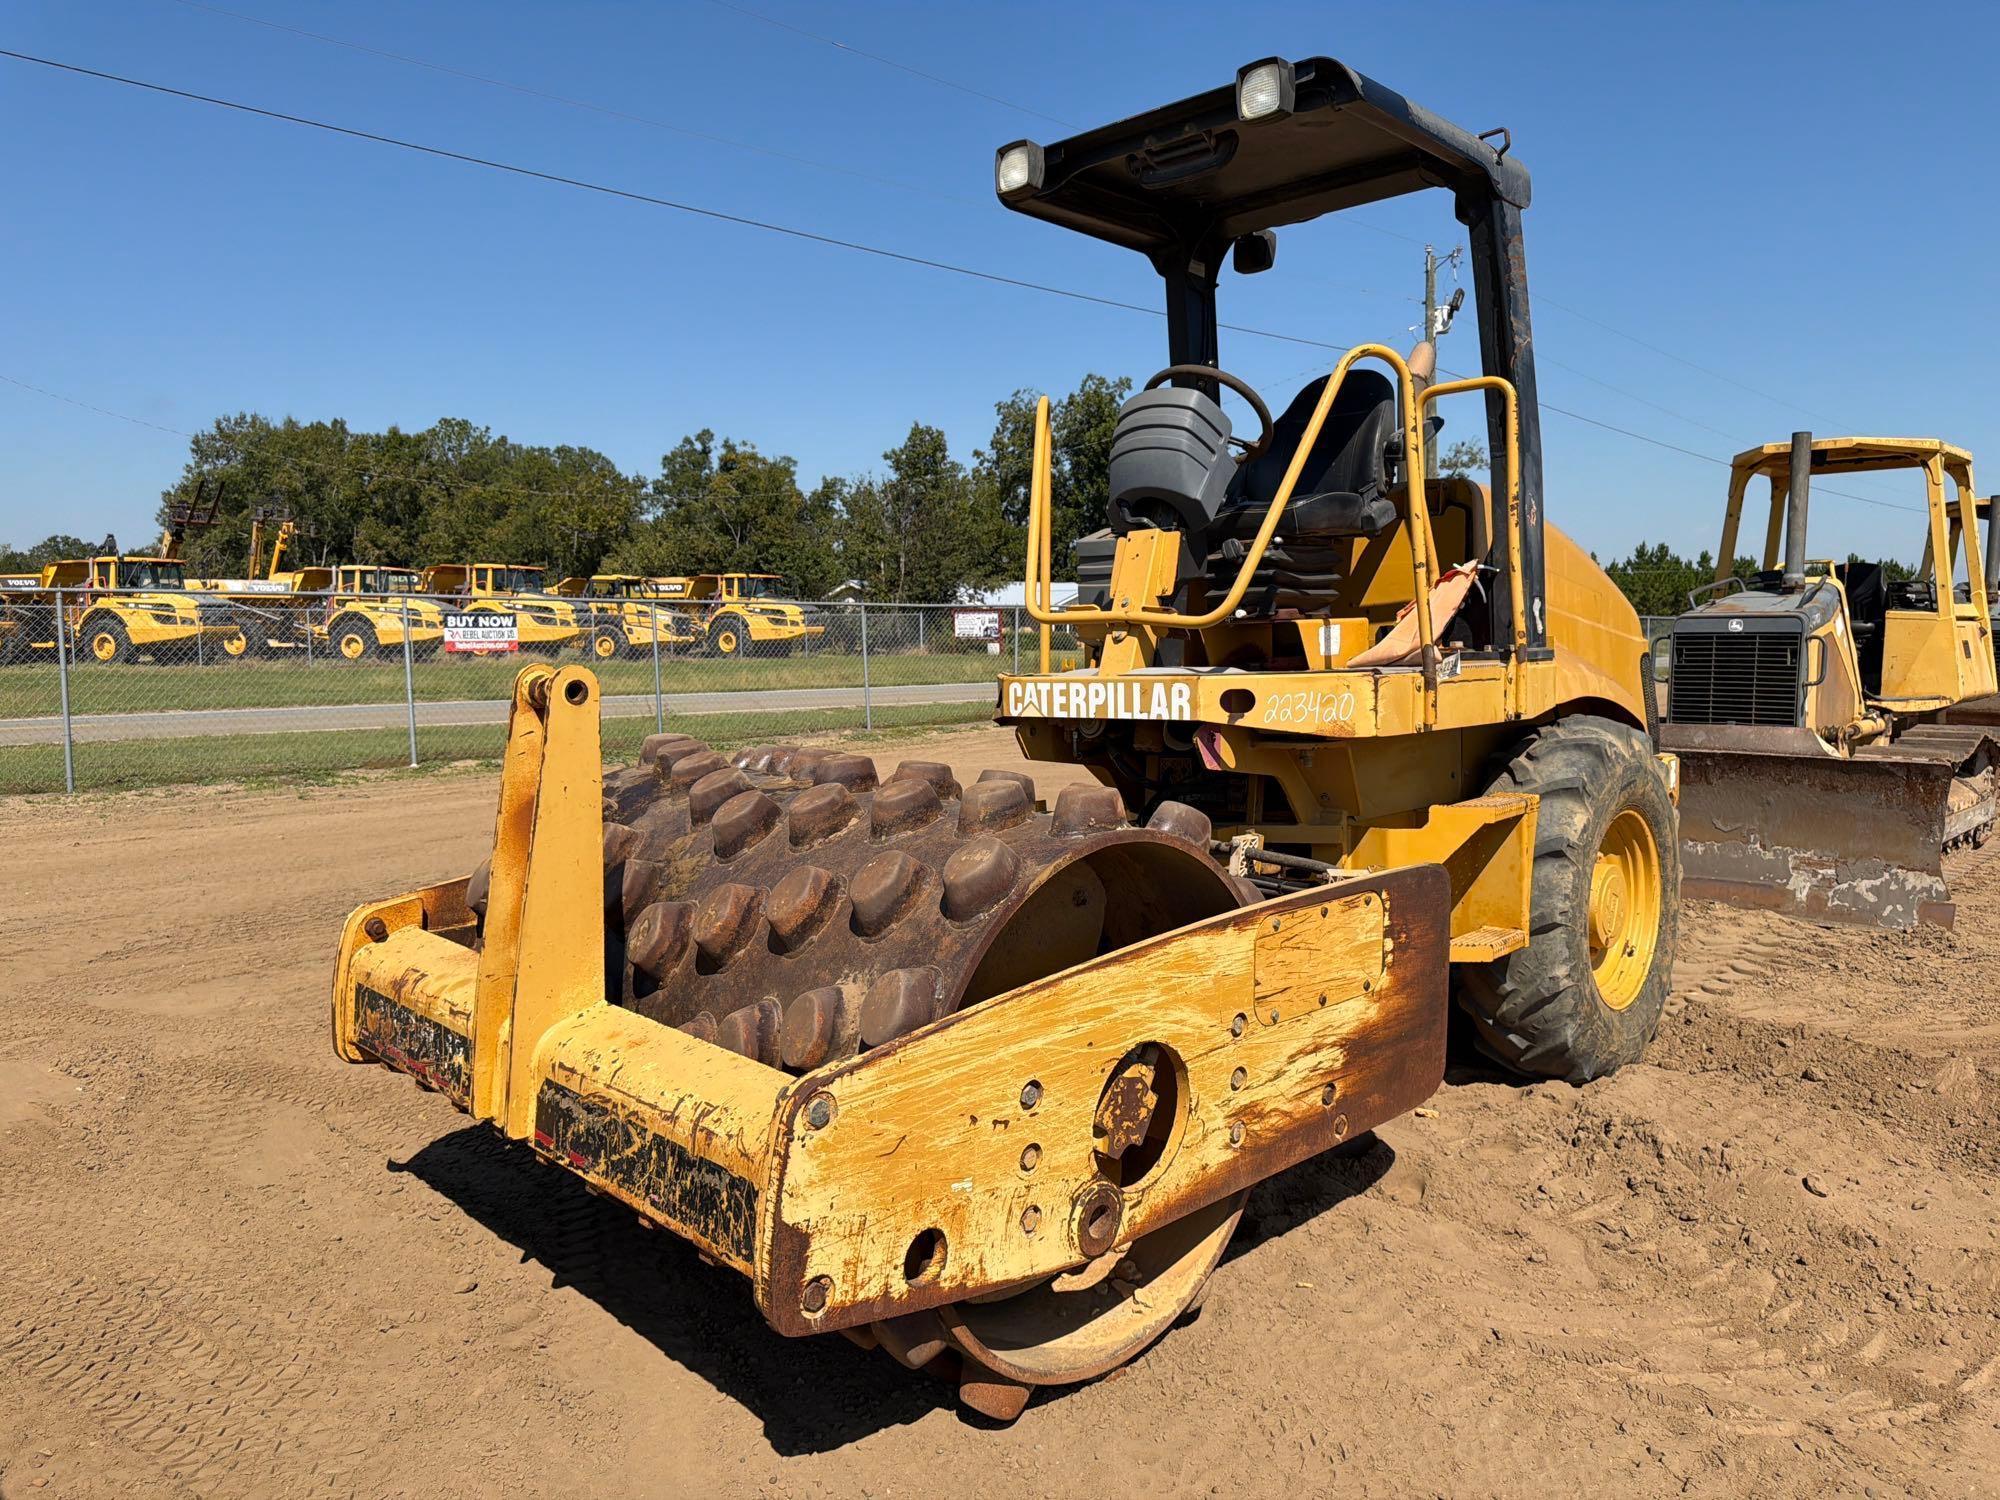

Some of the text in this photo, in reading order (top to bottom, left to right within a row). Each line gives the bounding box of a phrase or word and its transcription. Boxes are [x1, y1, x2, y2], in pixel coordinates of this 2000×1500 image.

[447, 615, 513, 627] BUY NOW
[462, 630, 480, 639] REBEL
[481, 630, 506, 639] AUCTION
[1009, 682, 1191, 720] CATERPILLAR
[1264, 690, 1355, 723] 223420
